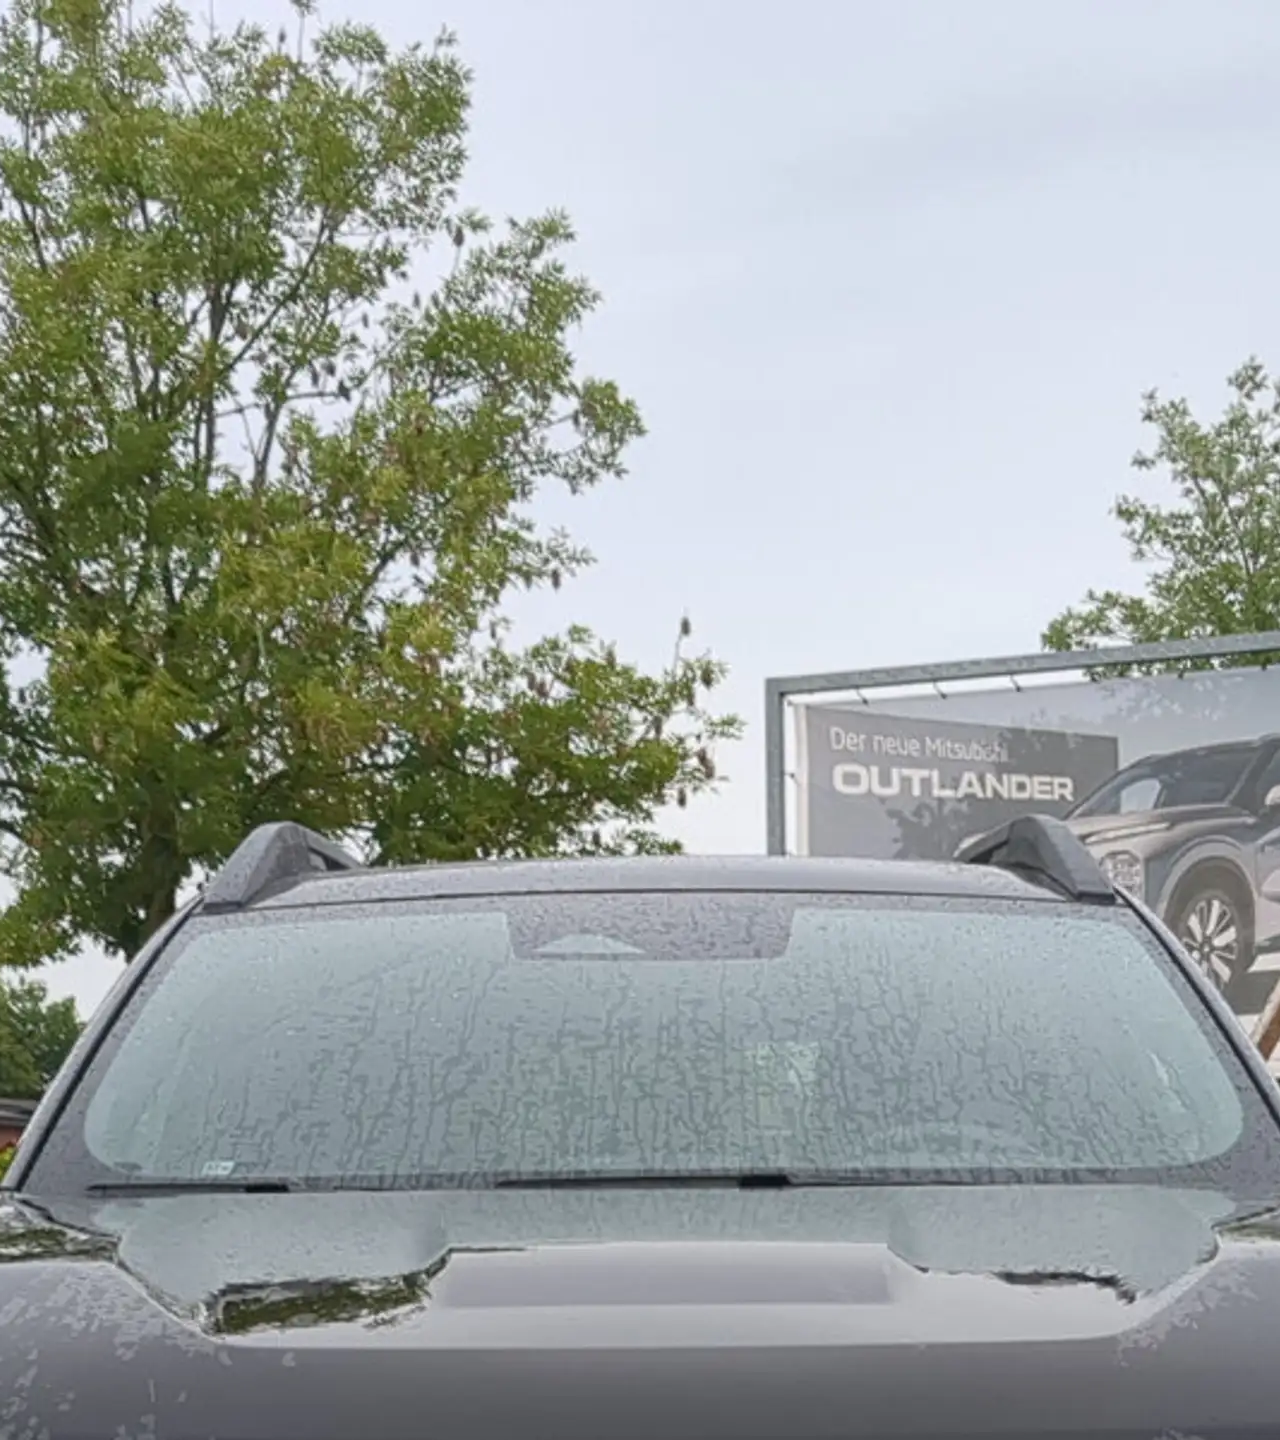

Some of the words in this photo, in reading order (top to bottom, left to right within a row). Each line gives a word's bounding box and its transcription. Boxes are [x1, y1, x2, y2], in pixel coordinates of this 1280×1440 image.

[830, 726, 867, 751] Der
[873, 733, 920, 757] neue
[832, 763, 1075, 801] OUTLANDER
